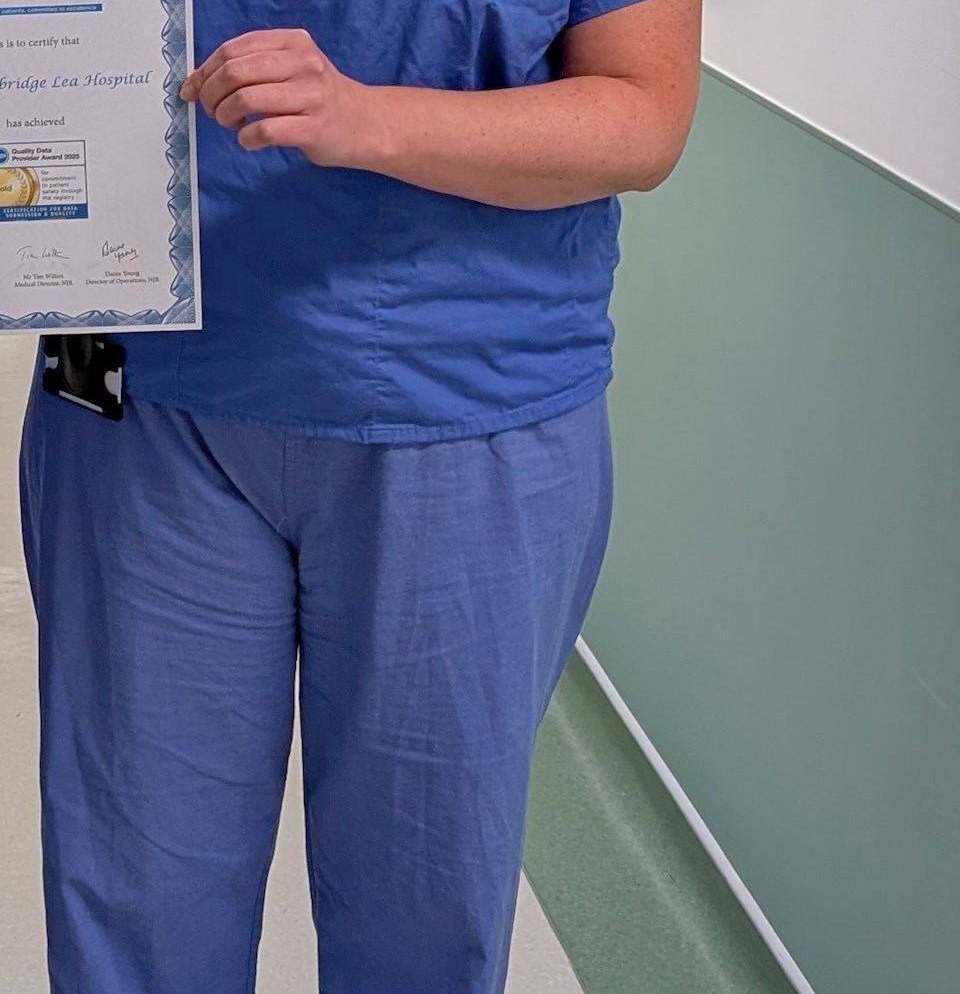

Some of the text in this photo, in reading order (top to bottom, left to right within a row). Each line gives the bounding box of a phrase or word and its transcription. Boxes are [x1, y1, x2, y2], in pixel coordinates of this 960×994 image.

[6, 39, 14, 48] is
[16, 38, 26, 48] to
[28, 36, 59, 48] certify
[61, 36, 80, 46] that
[51, 75, 79, 88] Lea
[83, 71, 153, 89] Hospital
[6, 116, 65, 128] has achieved
